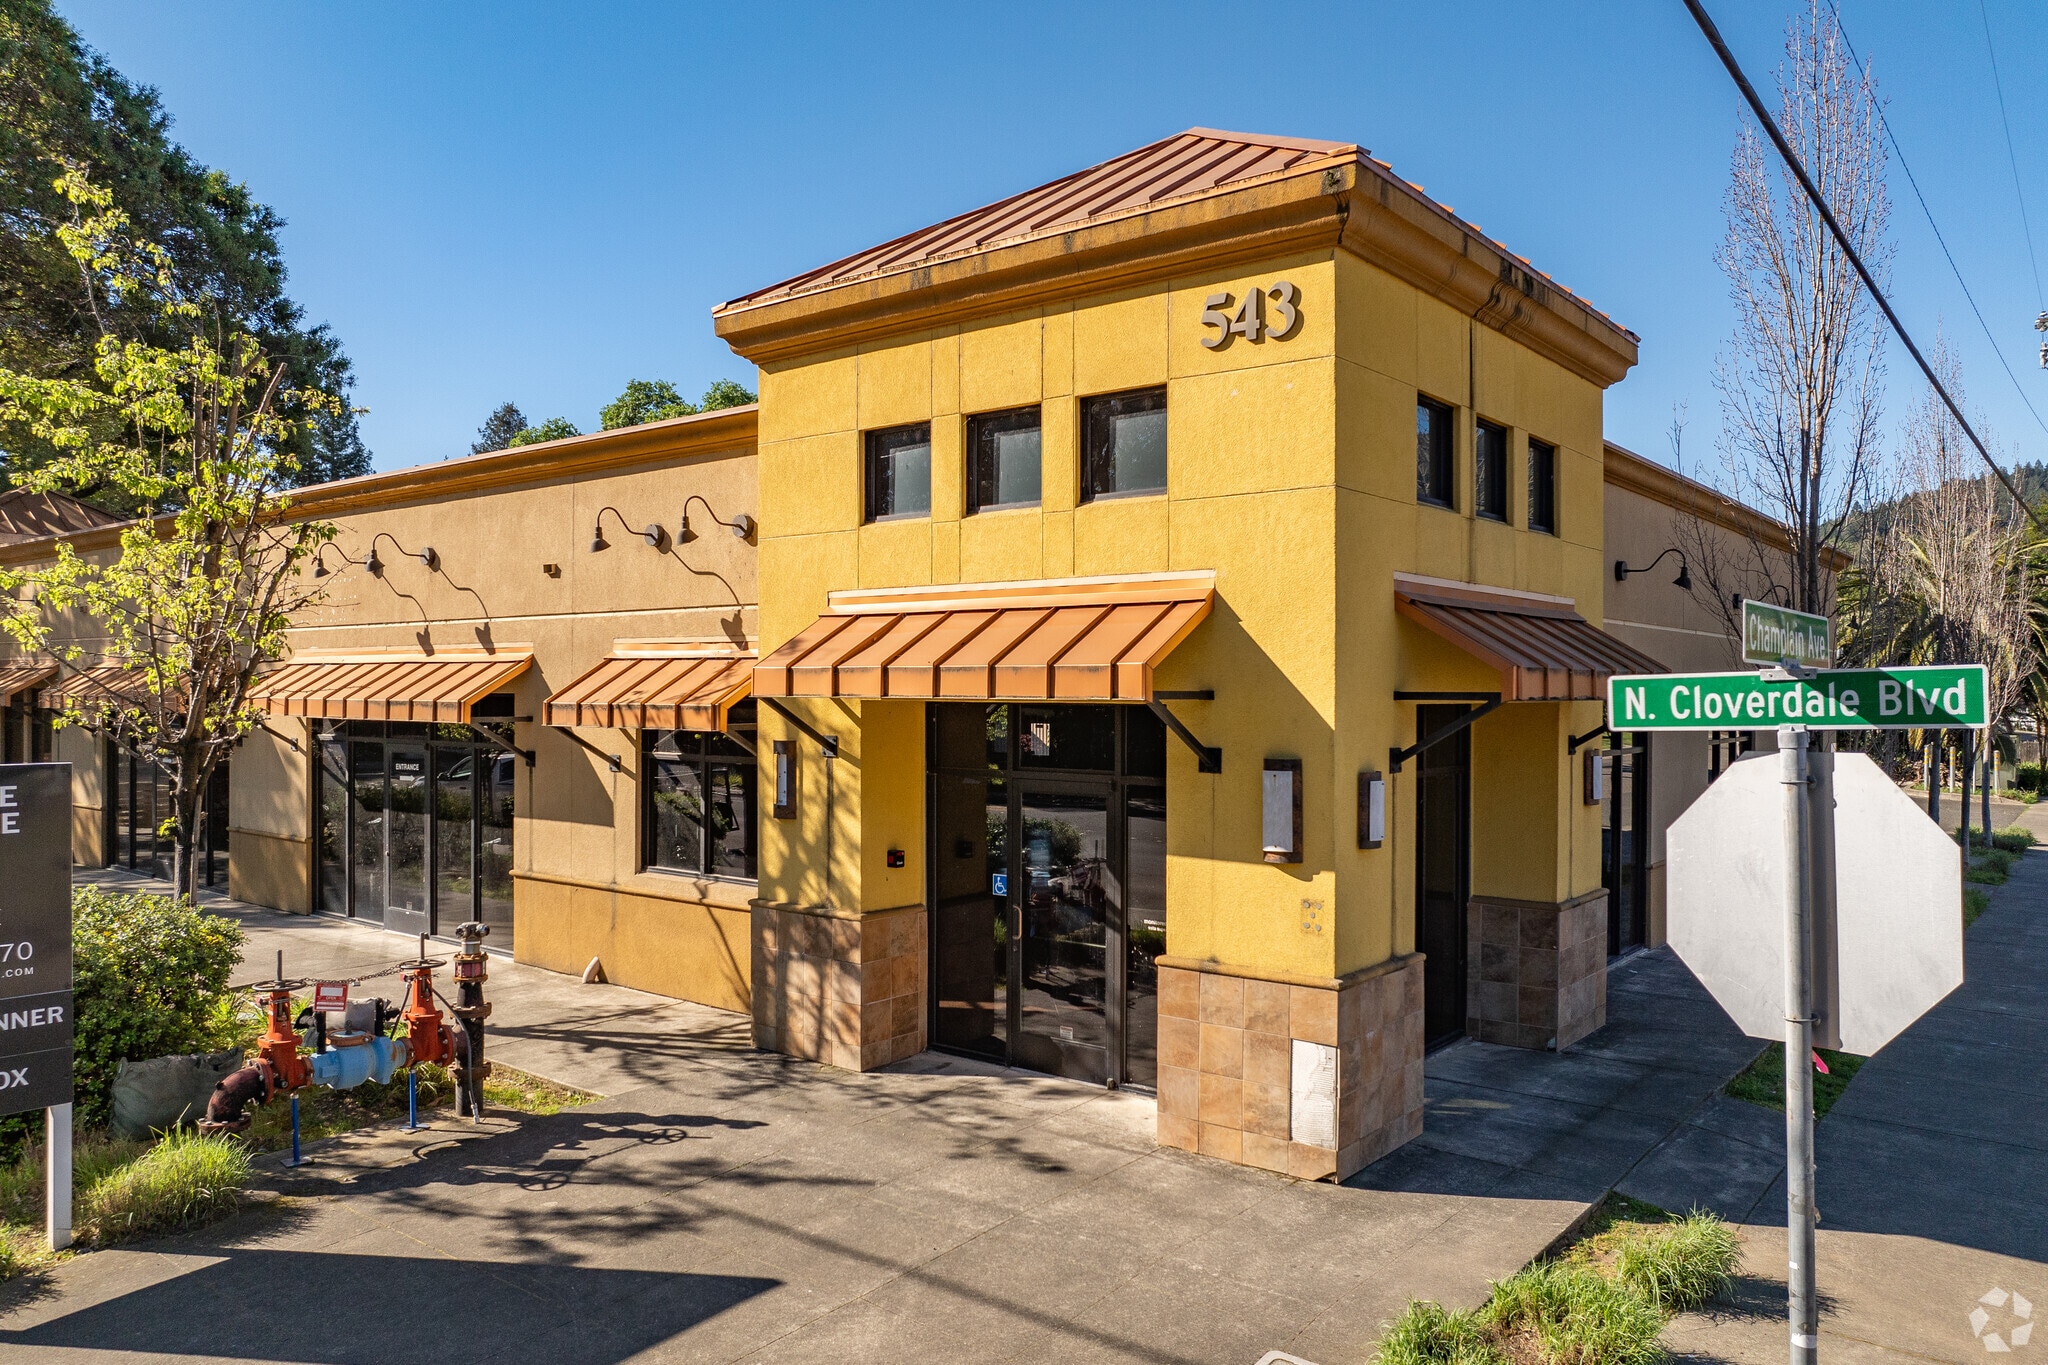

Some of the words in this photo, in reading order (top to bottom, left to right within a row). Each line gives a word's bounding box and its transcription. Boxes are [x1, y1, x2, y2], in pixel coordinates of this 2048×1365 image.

[1200, 281, 1296, 348] 543
[1749, 613, 1804, 658] Champlain
[1808, 625, 1826, 660] Ave
[1625, 686, 1656, 720] N.
[1670, 681, 1860, 720] Cloverdale
[1878, 677, 1967, 716] Blvd
[395, 763, 420, 771] ENTRANCE
